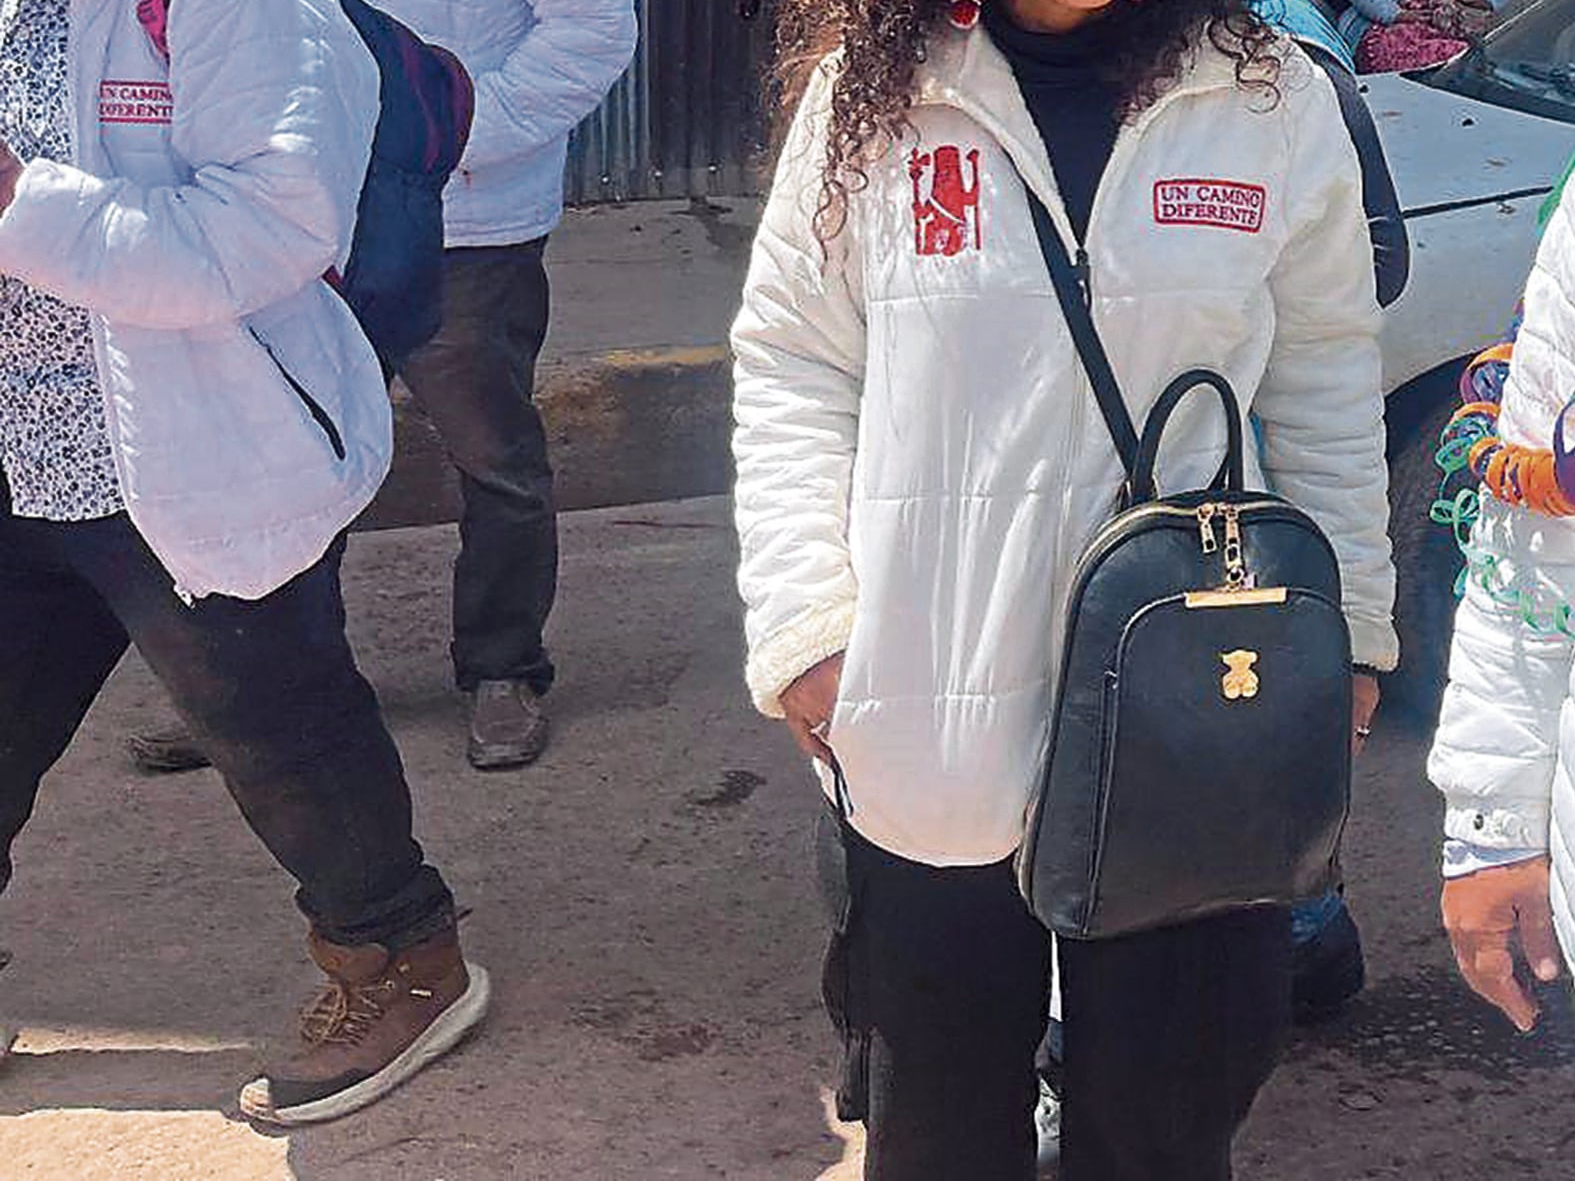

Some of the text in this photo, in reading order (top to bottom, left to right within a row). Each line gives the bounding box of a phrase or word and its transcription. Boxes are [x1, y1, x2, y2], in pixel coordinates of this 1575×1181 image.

[119, 86, 173, 101] CAMIN
[1161, 186, 1260, 209] UN CAMINO
[1161, 203, 1259, 225] DIFERENTE
